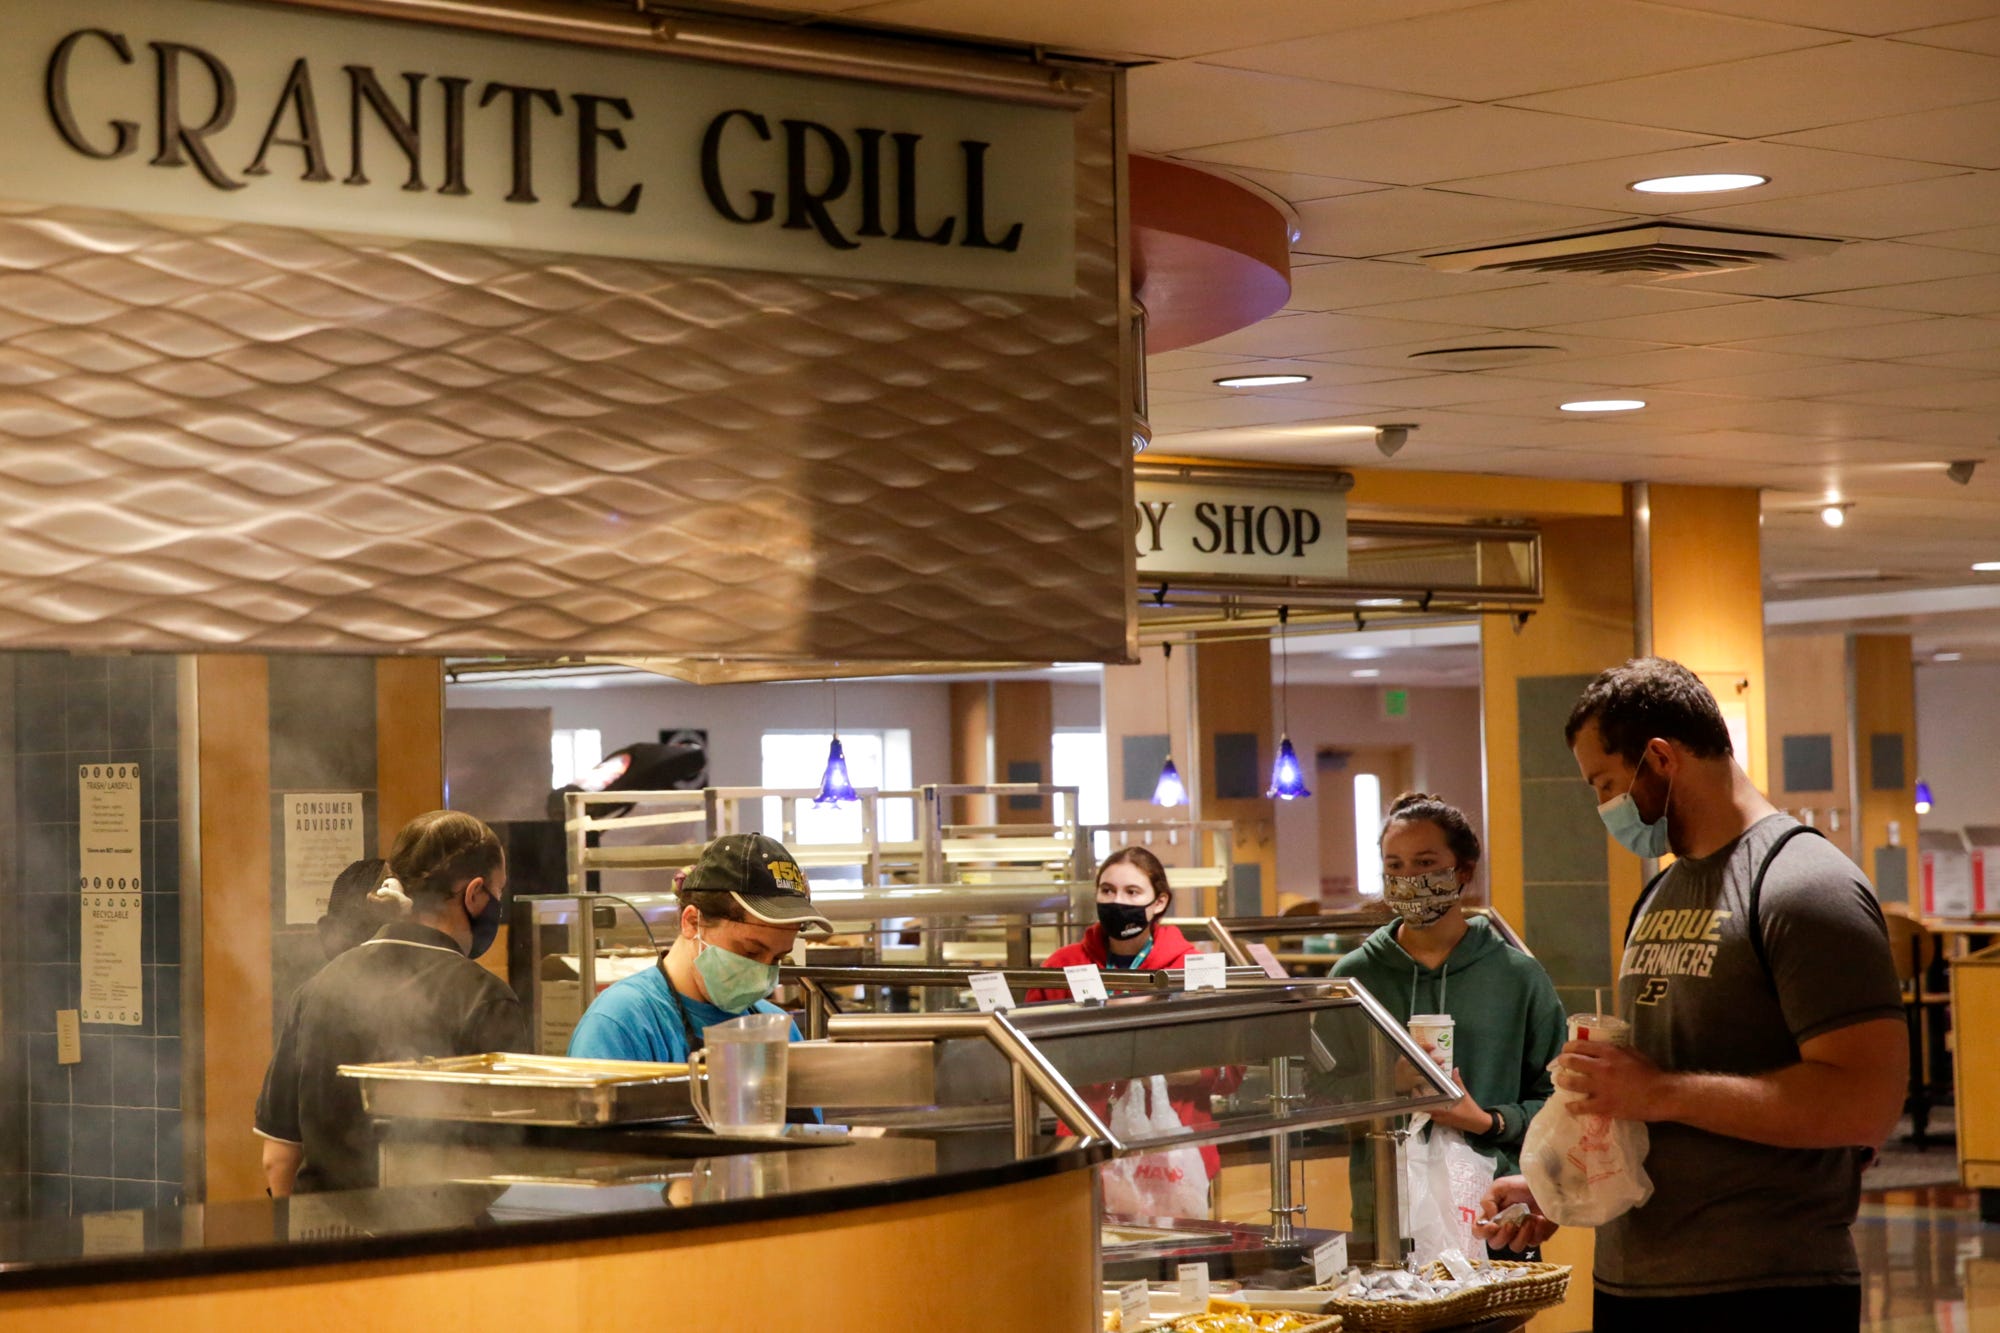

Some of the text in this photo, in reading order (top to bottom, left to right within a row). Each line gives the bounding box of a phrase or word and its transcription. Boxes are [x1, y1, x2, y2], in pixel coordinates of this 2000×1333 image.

[46, 28, 1024, 252] GRANITE GRILL
[1192, 502, 1321, 557] SHOP
[295, 802, 353, 815] CONSUMER
[296, 818, 353, 832] ADVISORY
[92, 910, 129, 919] RECYCLABLE
[1620, 943, 1718, 978] LERMAKERS
[1635, 978, 1669, 1006] P
